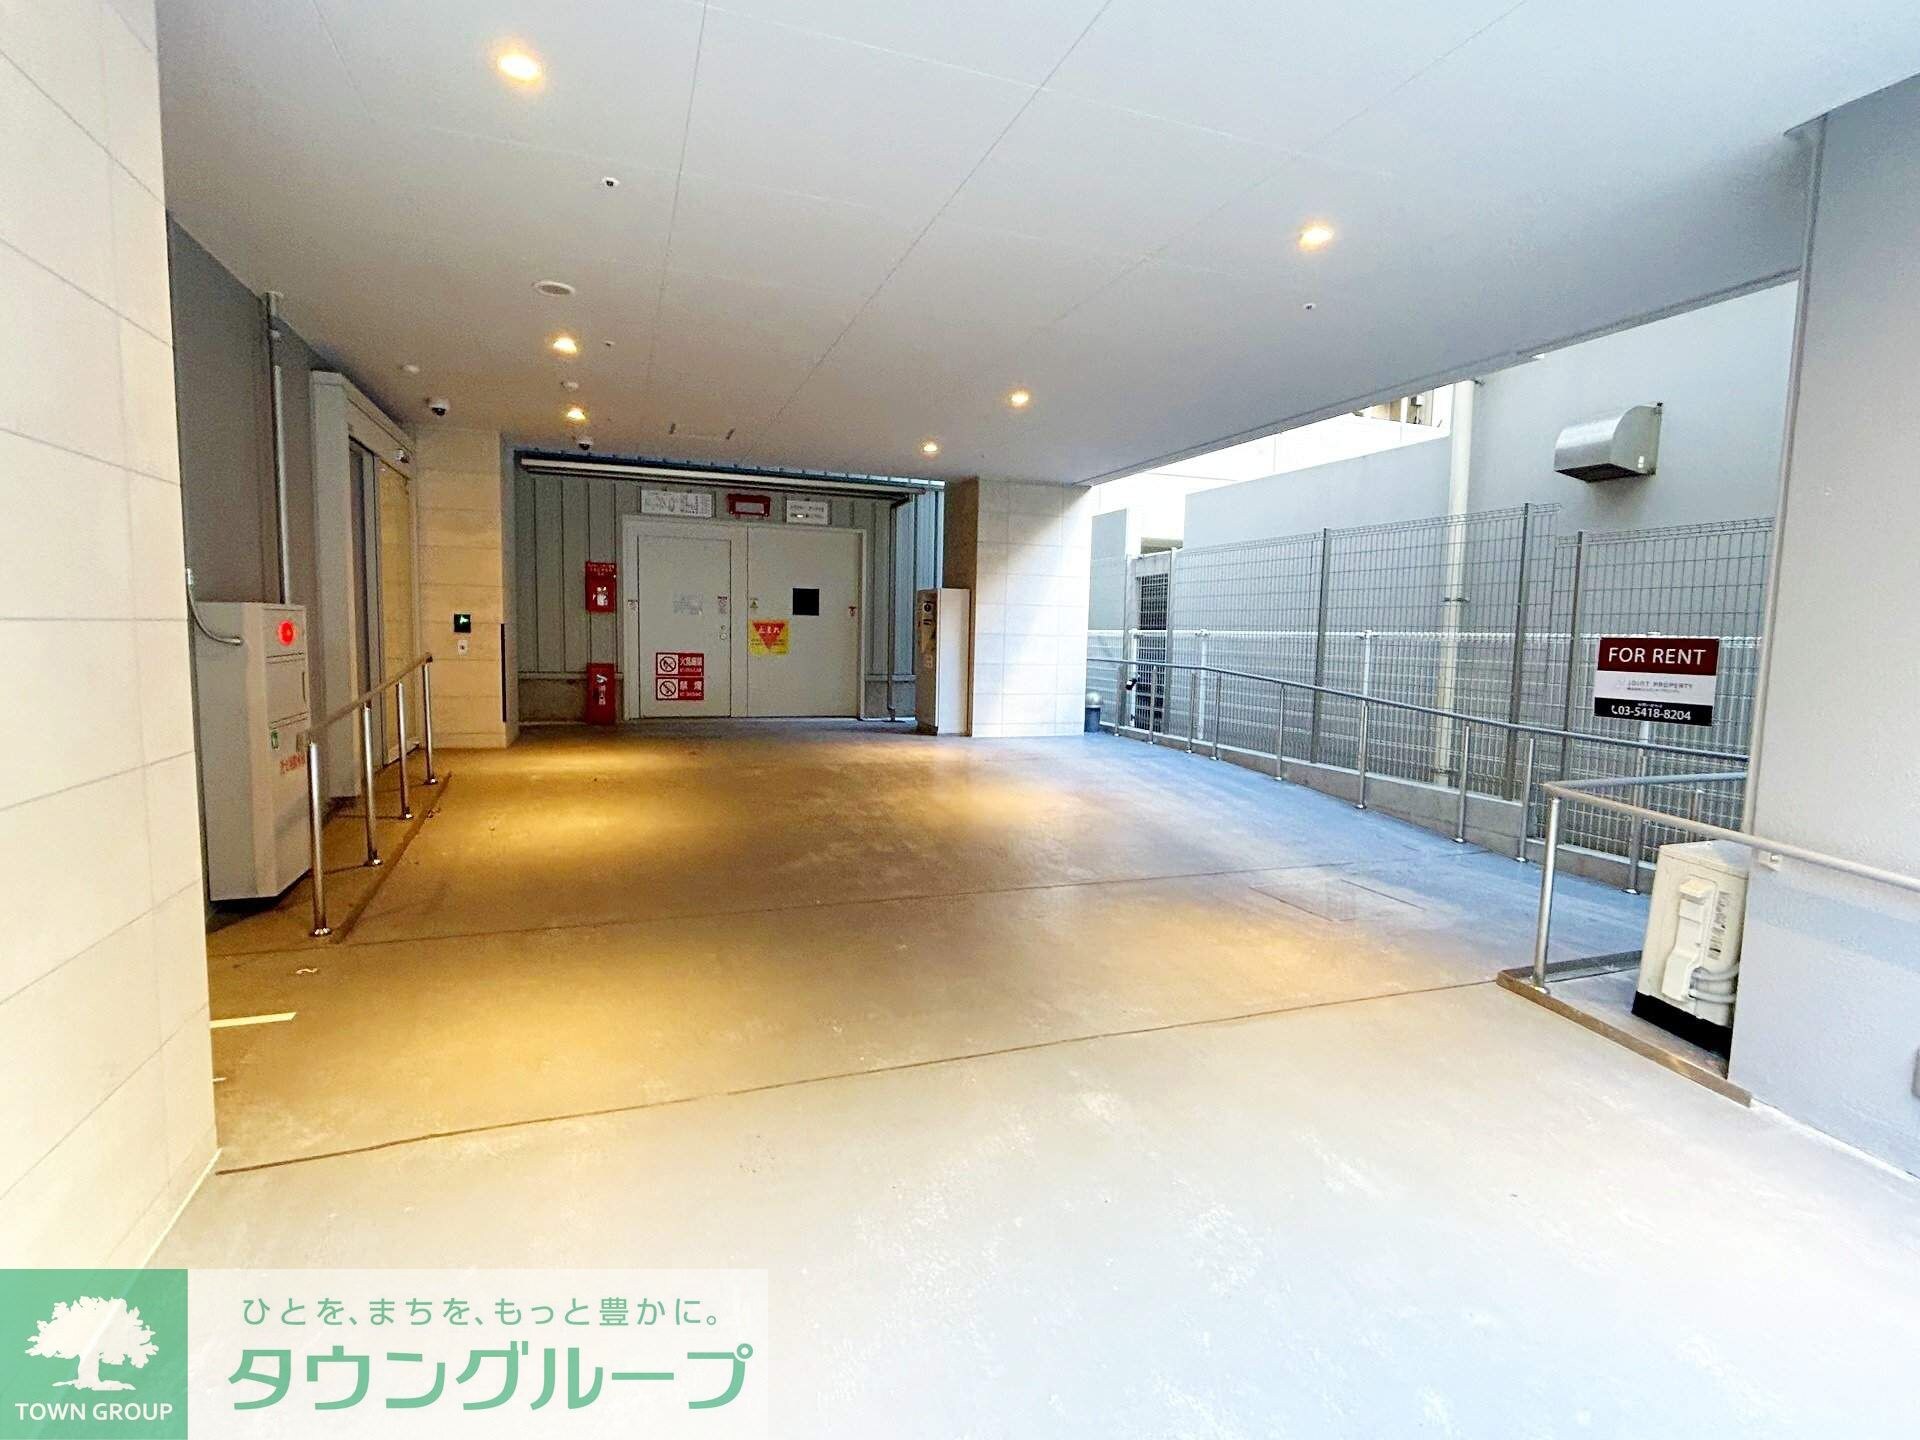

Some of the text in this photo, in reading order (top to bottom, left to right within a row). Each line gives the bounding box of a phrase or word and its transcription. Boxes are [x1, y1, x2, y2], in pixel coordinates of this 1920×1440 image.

[1608, 647, 1707, 665] FOR RENT
[1617, 704, 1692, 721] 03-5418-8204
